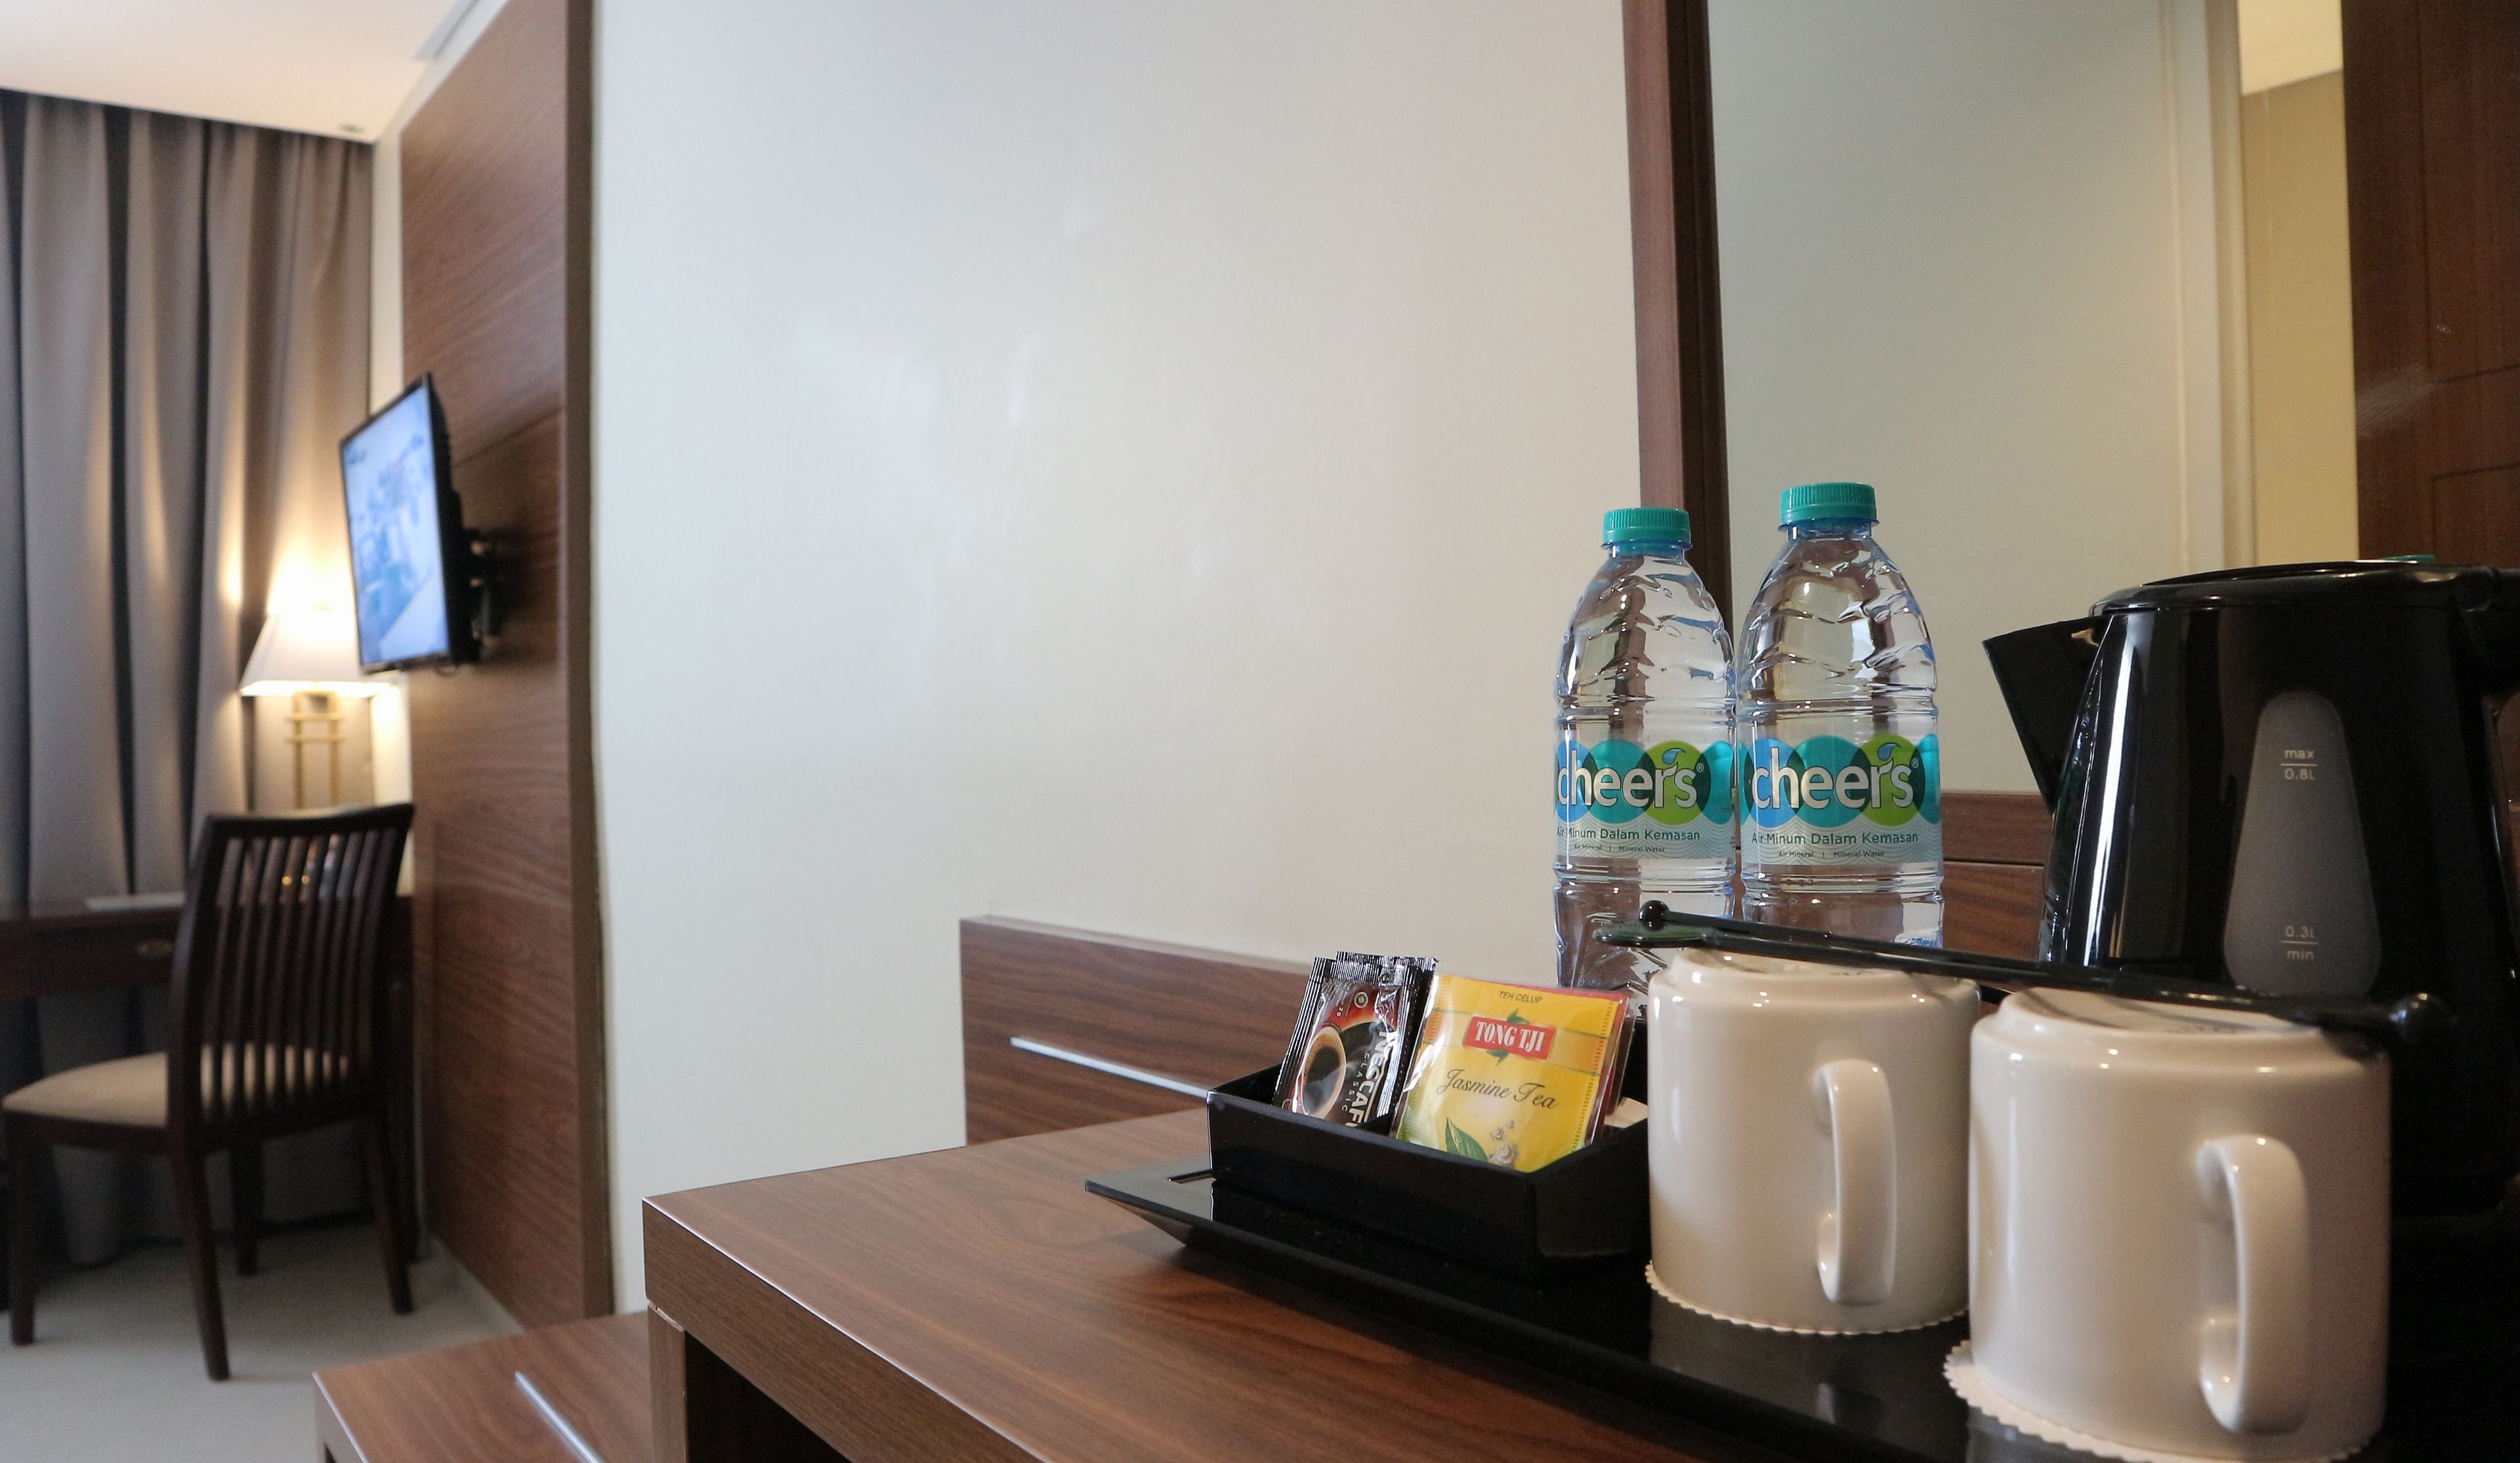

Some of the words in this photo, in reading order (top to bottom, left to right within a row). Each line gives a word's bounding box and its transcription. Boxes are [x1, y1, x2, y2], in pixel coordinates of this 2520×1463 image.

[2284, 749, 2315, 759] max
[1557, 749, 1698, 809] cheers
[1752, 747, 1914, 809] cheers
[1566, 828, 1596, 839] Minum
[1600, 828, 1640, 840] Dalam
[1645, 829, 1700, 841] Kemasan
[1752, 832, 1765, 843] Air
[1765, 832, 1806, 844] Minum
[1811, 832, 1857, 845] Dalam
[1862, 832, 1918, 844] Kemasan
[2287, 949, 2314, 960] min
[1499, 990, 1514, 1000] TEH
[1515, 993, 1542, 1004] CELUP
[1475, 1021, 1517, 1046] TONG
[1518, 1028, 1546, 1053] TJI
[1341, 1052, 1371, 1112] CLASSIC
[1345, 1031, 1392, 1128] NESCAF
[1436, 1069, 1512, 1099] Jasmine
[1513, 1082, 1559, 1109] Tea
